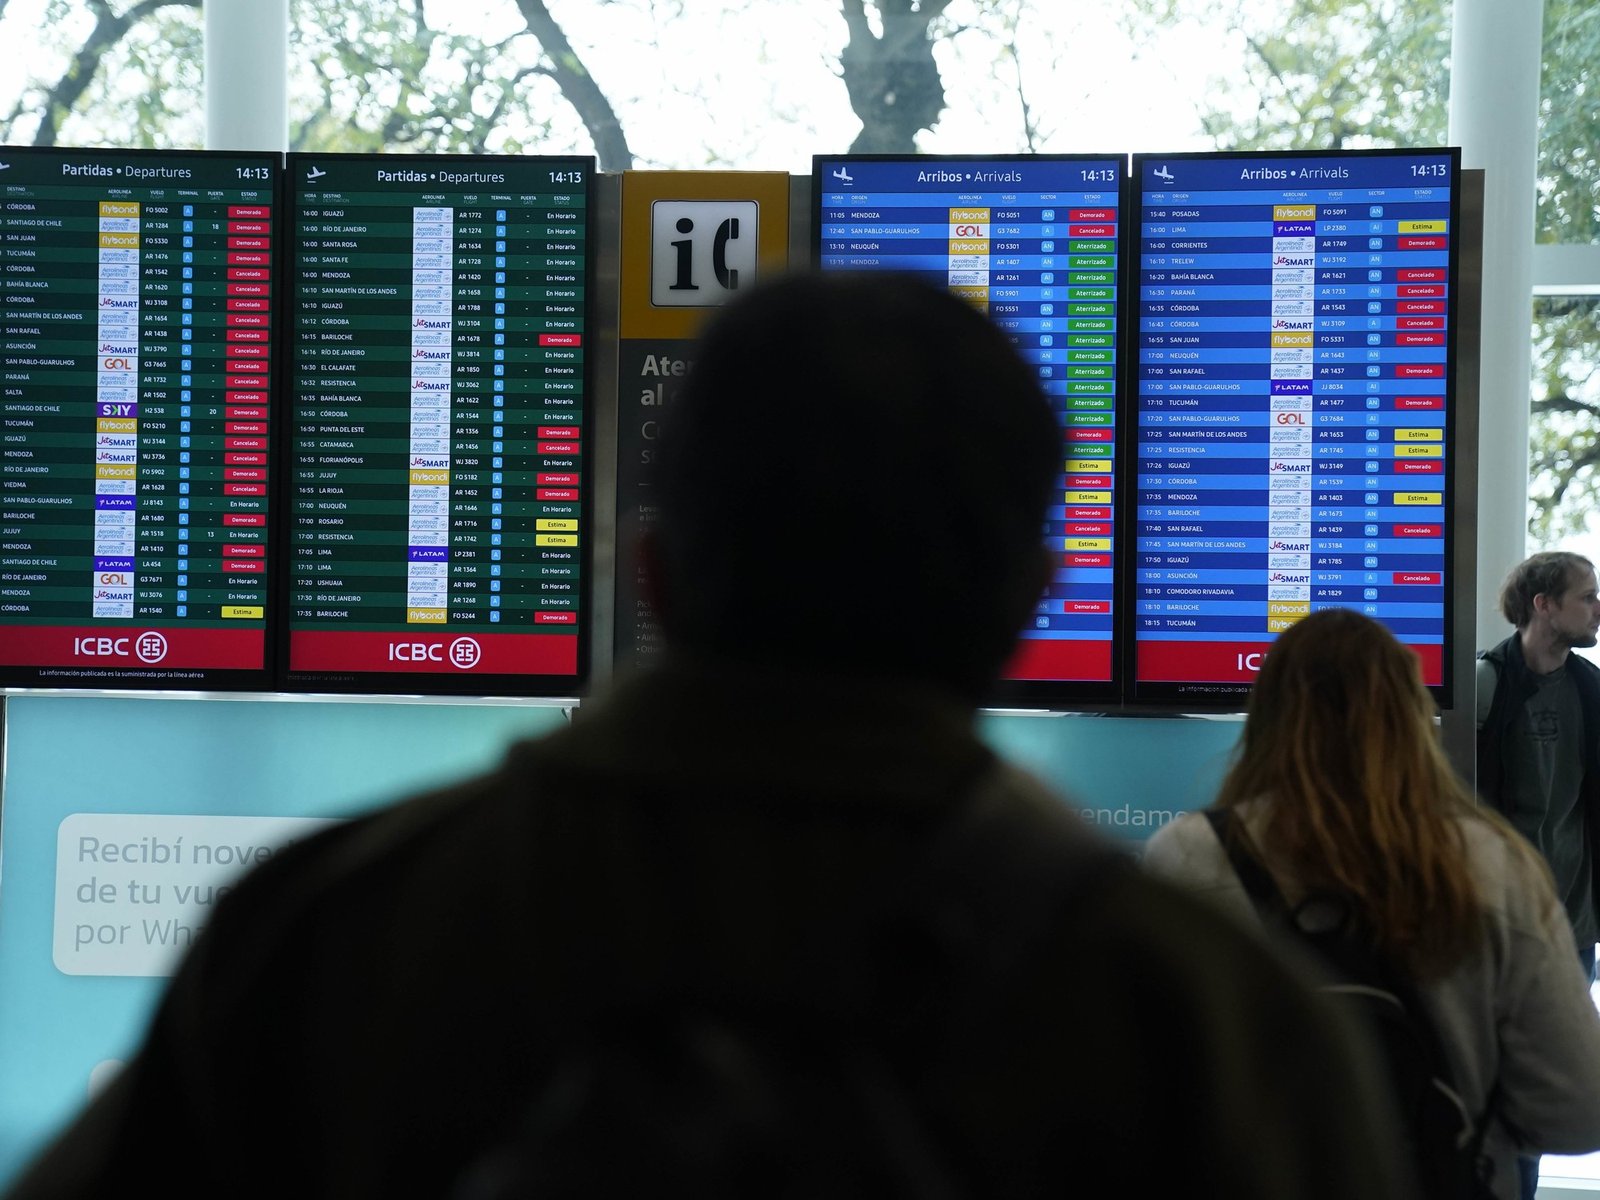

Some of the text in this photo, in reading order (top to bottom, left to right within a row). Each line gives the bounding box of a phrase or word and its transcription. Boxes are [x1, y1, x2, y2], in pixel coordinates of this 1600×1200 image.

[63, 164, 191, 179] Partidas Departures
[236, 168, 268, 179] 14:13
[918, 170, 1022, 182] Arribos Arrivals
[1081, 170, 1114, 181] 14:13
[1241, 166, 1348, 179] Arribos Arrivals
[1411, 164, 1446, 176] 14:13
[378, 170, 504, 184] Partidas Departures
[549, 172, 581, 183] 14:13
[956, 226, 982, 237] GOL
[105, 358, 131, 370] GOL
[640, 383, 663, 406] al
[1277, 413, 1305, 424] GOL
[75, 638, 129, 655] ICBC
[389, 643, 442, 661] ICBC
[1238, 654, 1266, 670] IC
[78, 836, 183, 863] Recibí
[76, 877, 233, 904] de tu vue
[75, 924, 131, 952] por
